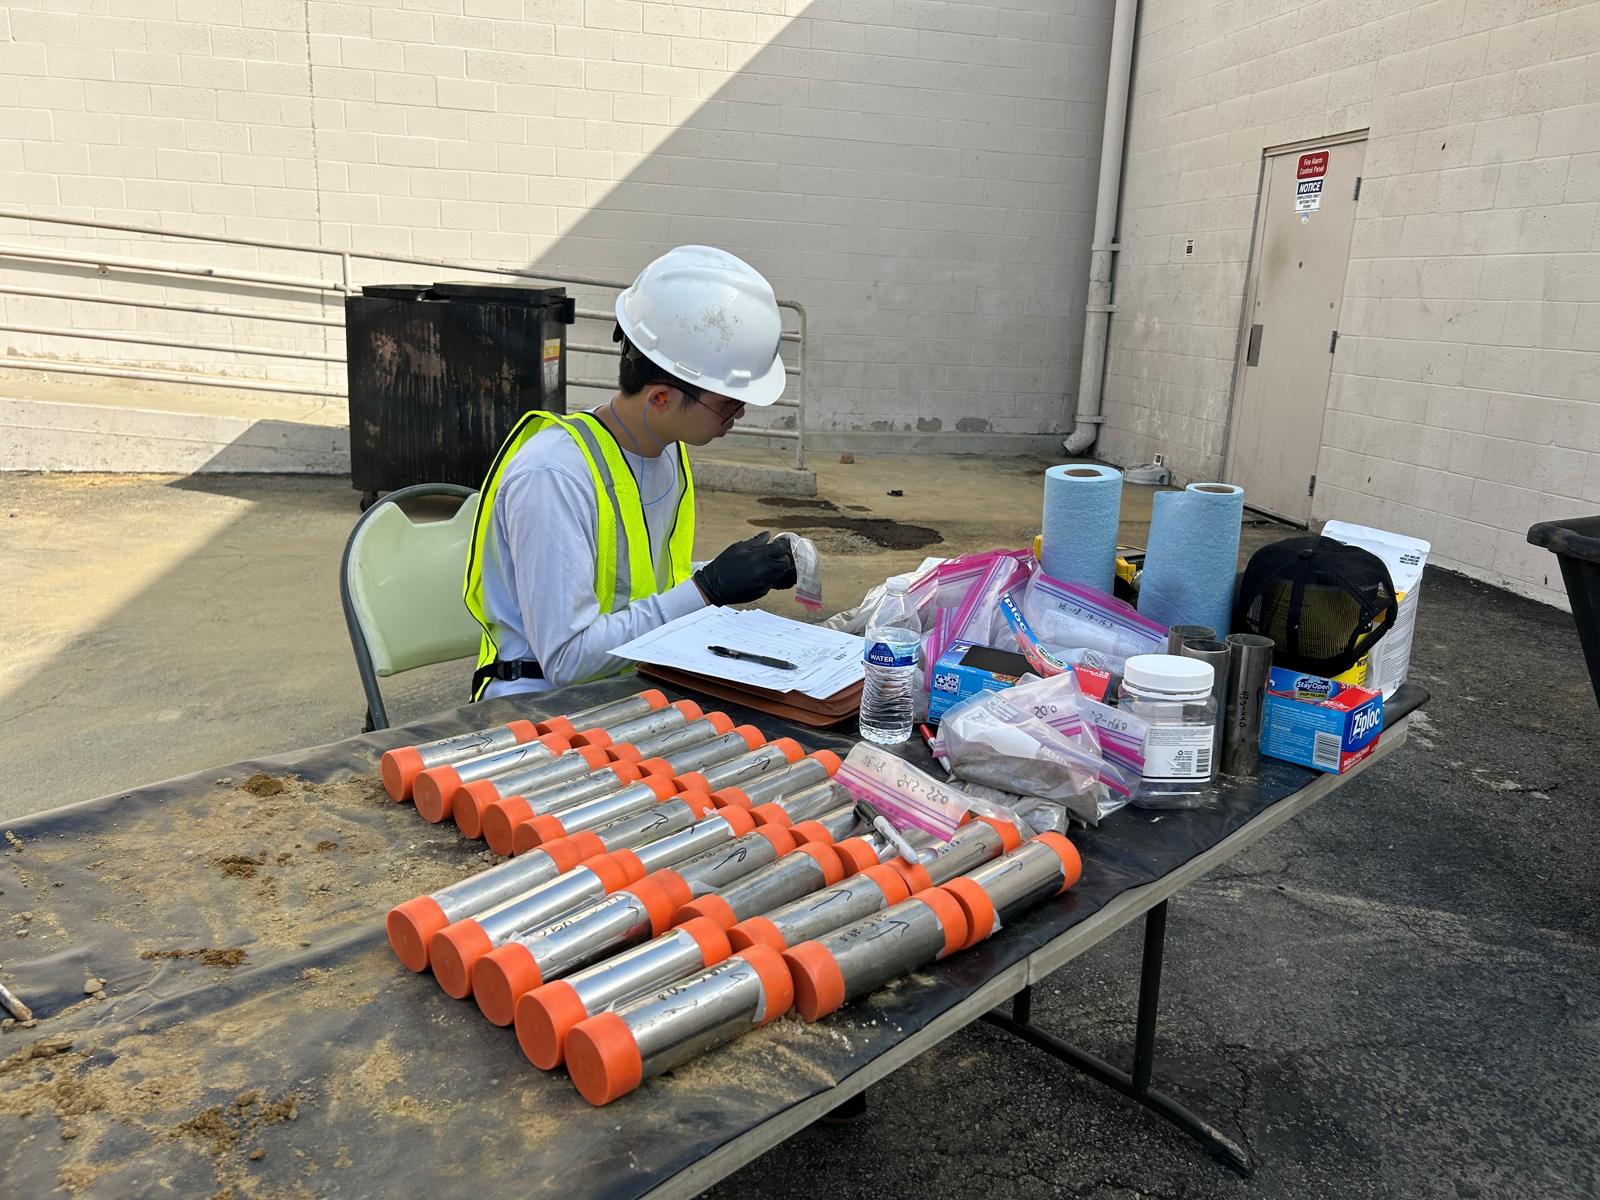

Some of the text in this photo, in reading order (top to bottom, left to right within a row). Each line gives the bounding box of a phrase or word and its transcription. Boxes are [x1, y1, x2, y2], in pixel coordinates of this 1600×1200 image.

[1300, 167, 1313, 175] Control
[1299, 181, 1322, 193] NOTICE
[870, 654, 894, 663] WATER
[1296, 681, 1330, 690] Stay Open
[1352, 707, 1381, 739] Ziploc
